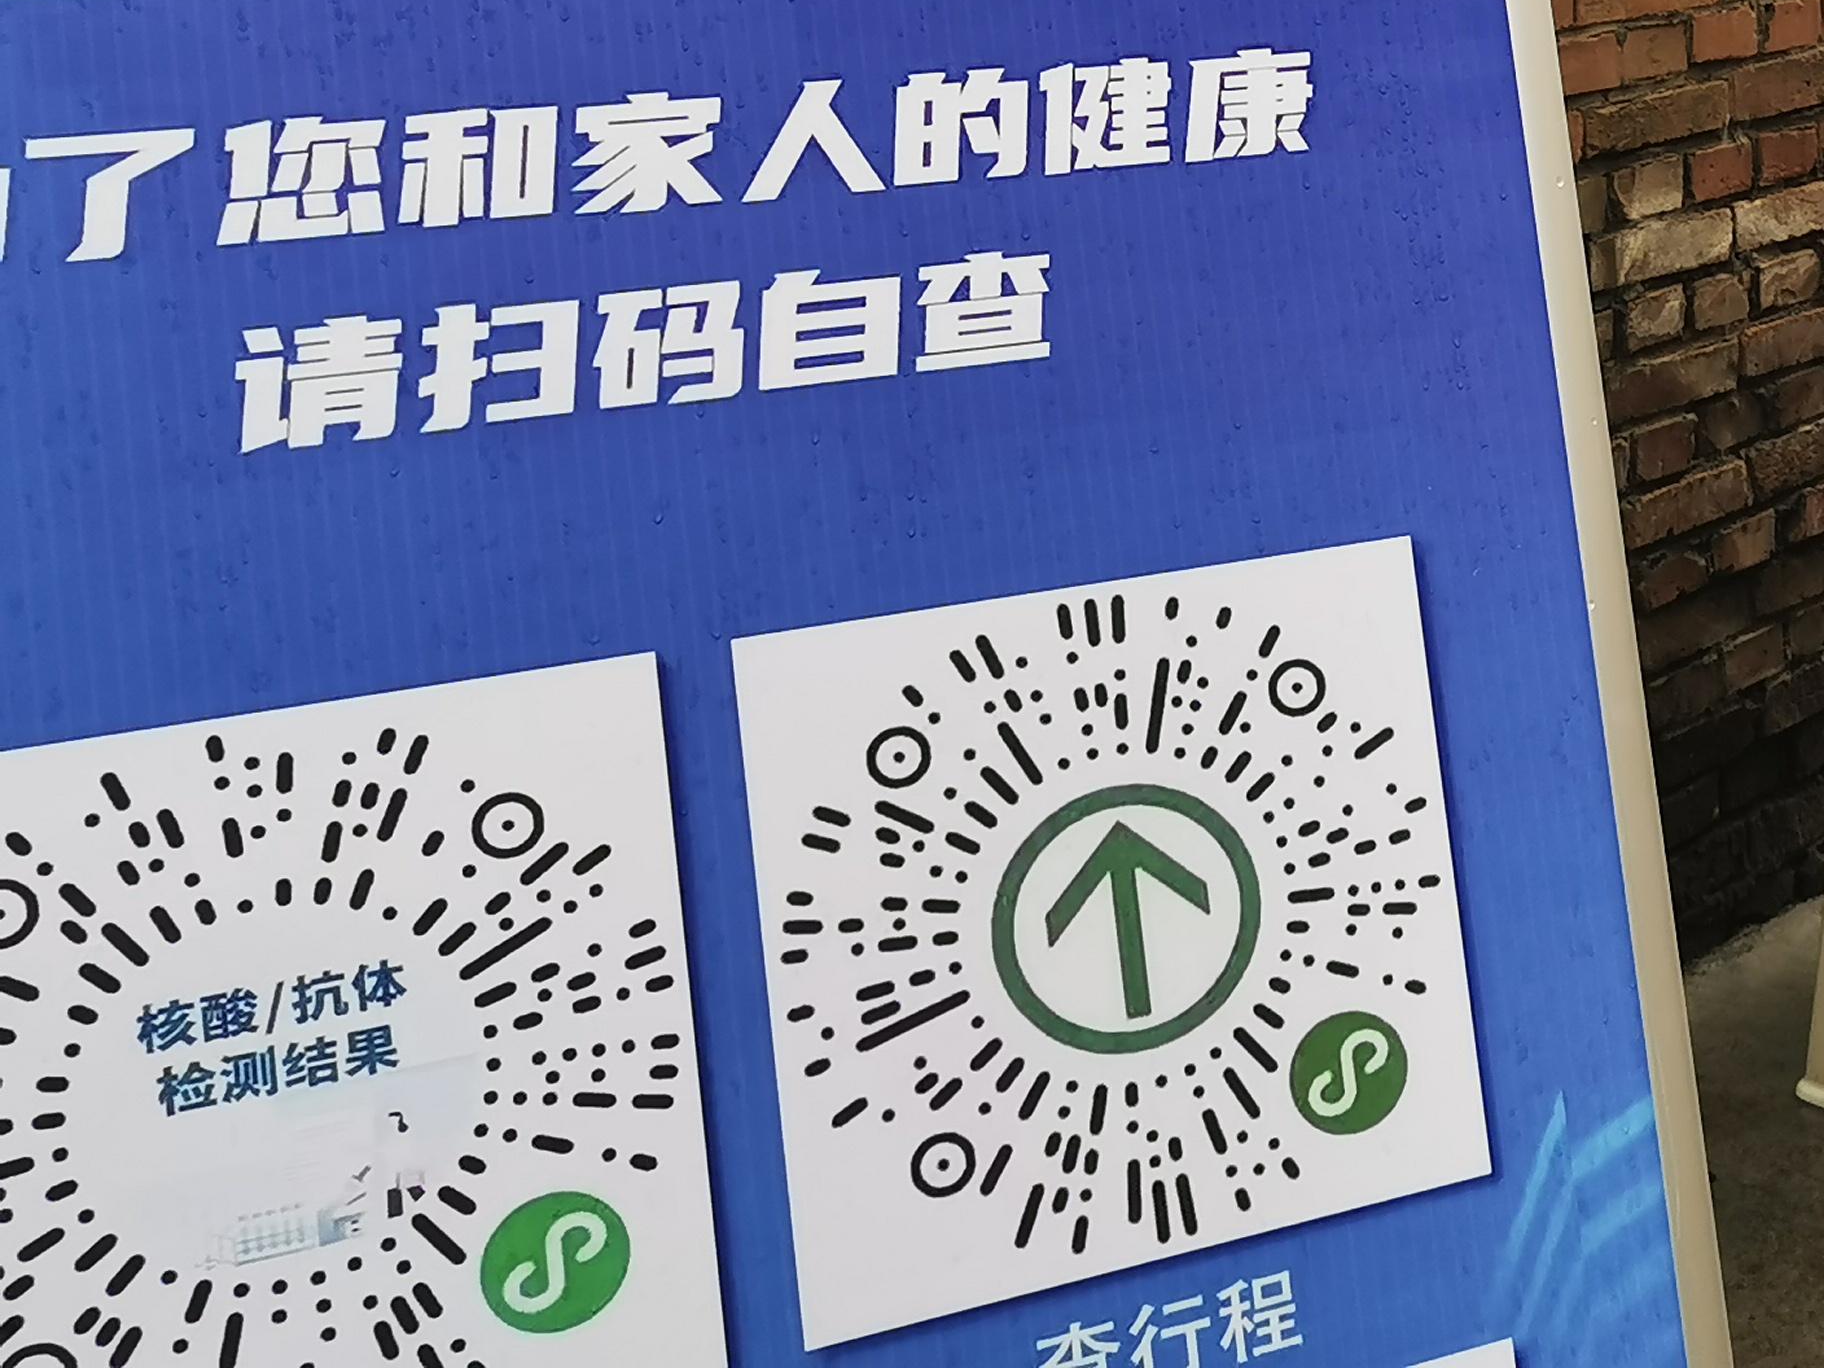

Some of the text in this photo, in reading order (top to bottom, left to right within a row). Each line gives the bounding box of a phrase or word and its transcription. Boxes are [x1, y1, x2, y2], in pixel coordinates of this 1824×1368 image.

[0, 49, 1312, 264] 了您和家人的健康
[235, 251, 1052, 454] 请扫码自查
[136, 959, 408, 1054] 核酸/抗体
[156, 1024, 400, 1117] 检测结果
